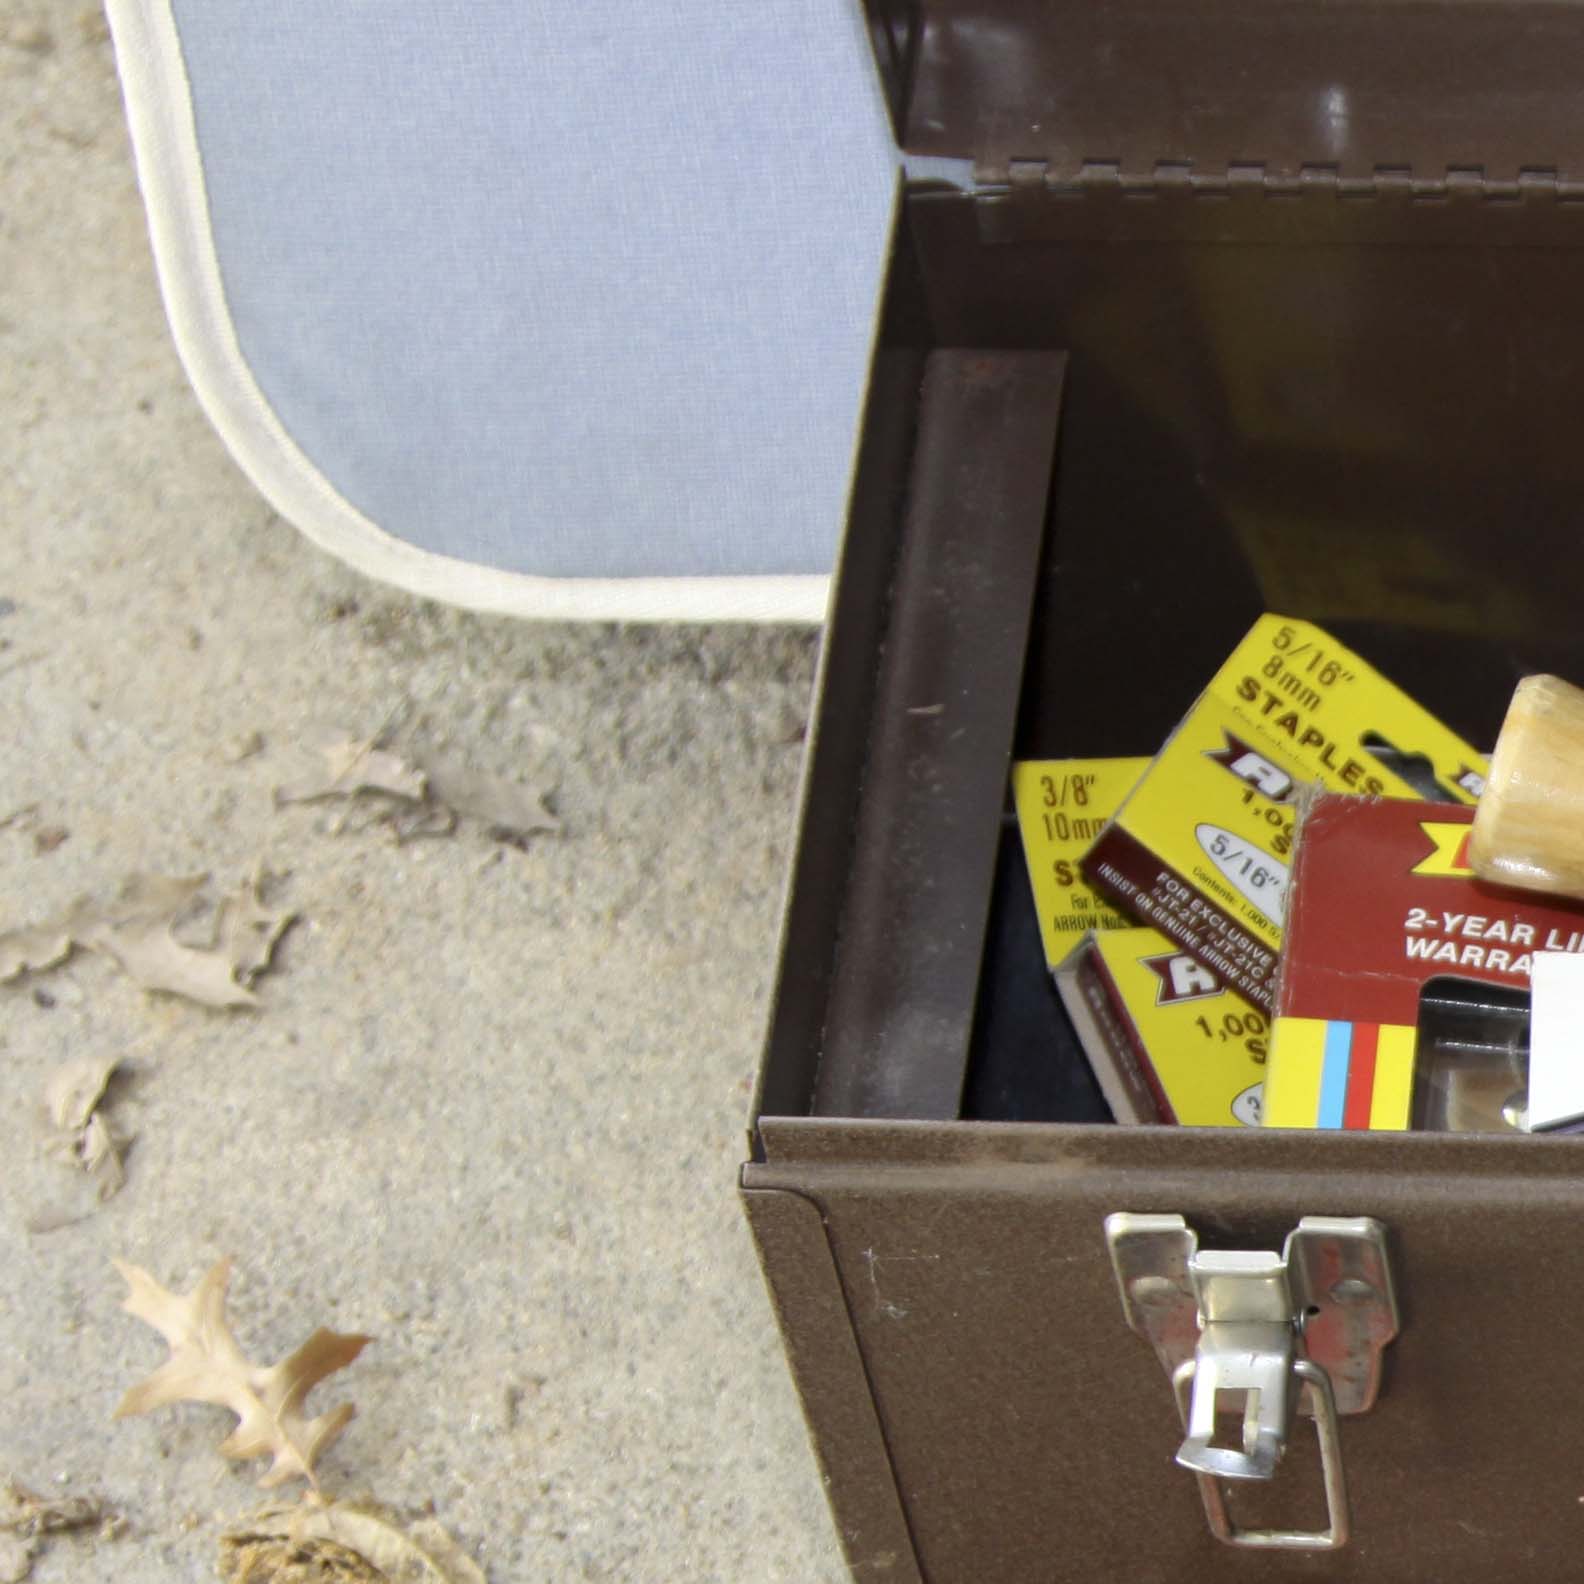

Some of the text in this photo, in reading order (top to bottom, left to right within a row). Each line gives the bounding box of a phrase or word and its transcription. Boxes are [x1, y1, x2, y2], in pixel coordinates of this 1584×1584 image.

[1261, 655, 1322, 712] 8mm
[1236, 675, 1386, 796] STAPLES
[1053, 913, 1098, 933] ARROW
[1097, 862, 1137, 897] INSIST
[1135, 893, 1153, 912] ON
[1151, 905, 1201, 948] GENUINE
[1199, 943, 1241, 980] ARROW
[1156, 871, 1274, 968] FOR EXCLUSIVE
[1404, 906, 1537, 946] 2-YEAR
[1404, 936, 1534, 977] WARRA
